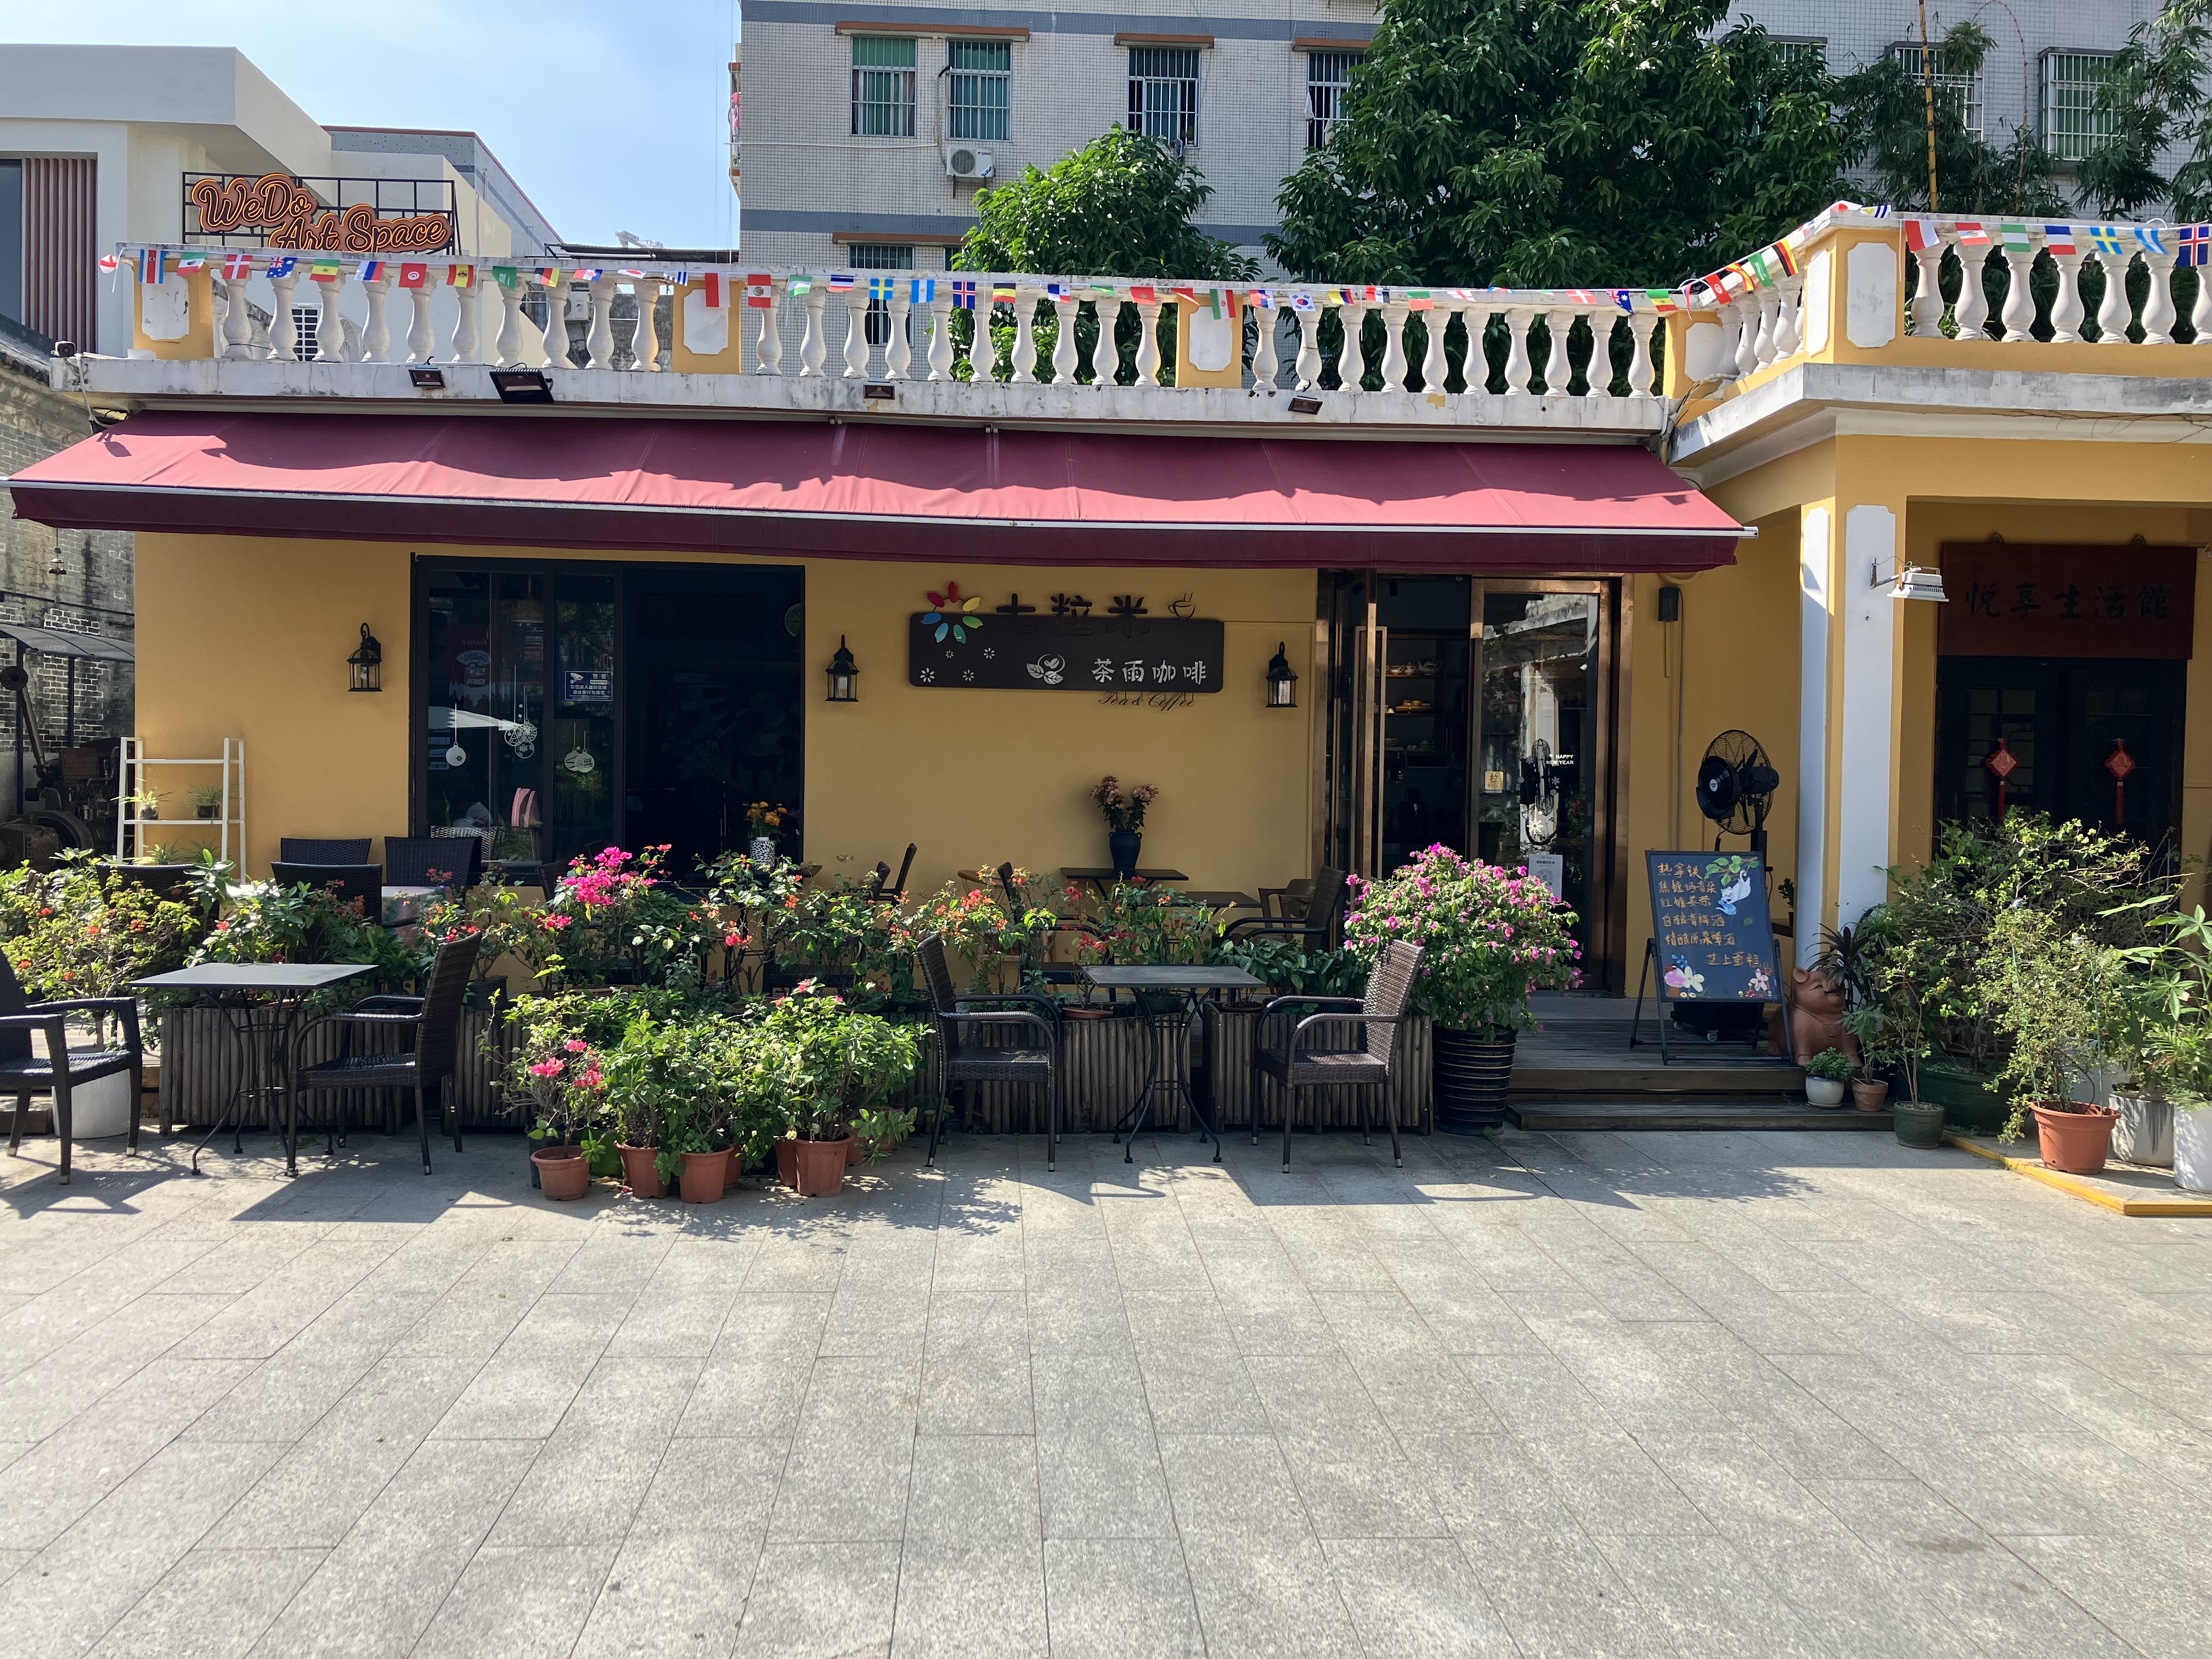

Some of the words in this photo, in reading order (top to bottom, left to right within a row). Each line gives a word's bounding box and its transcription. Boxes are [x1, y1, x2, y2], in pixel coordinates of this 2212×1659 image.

[276, 216, 340, 251] Art
[346, 210, 447, 252] Space
[996, 592, 1150, 639] 七粒米
[1091, 658, 1206, 685] 茶雨咖啡
[1098, 691, 1129, 705] Tea
[1131, 695, 1144, 706] &
[1147, 691, 1195, 712] Coffee
[1488, 774, 1499, 783] 拉
[1657, 862, 1703, 880] 热拿铁
